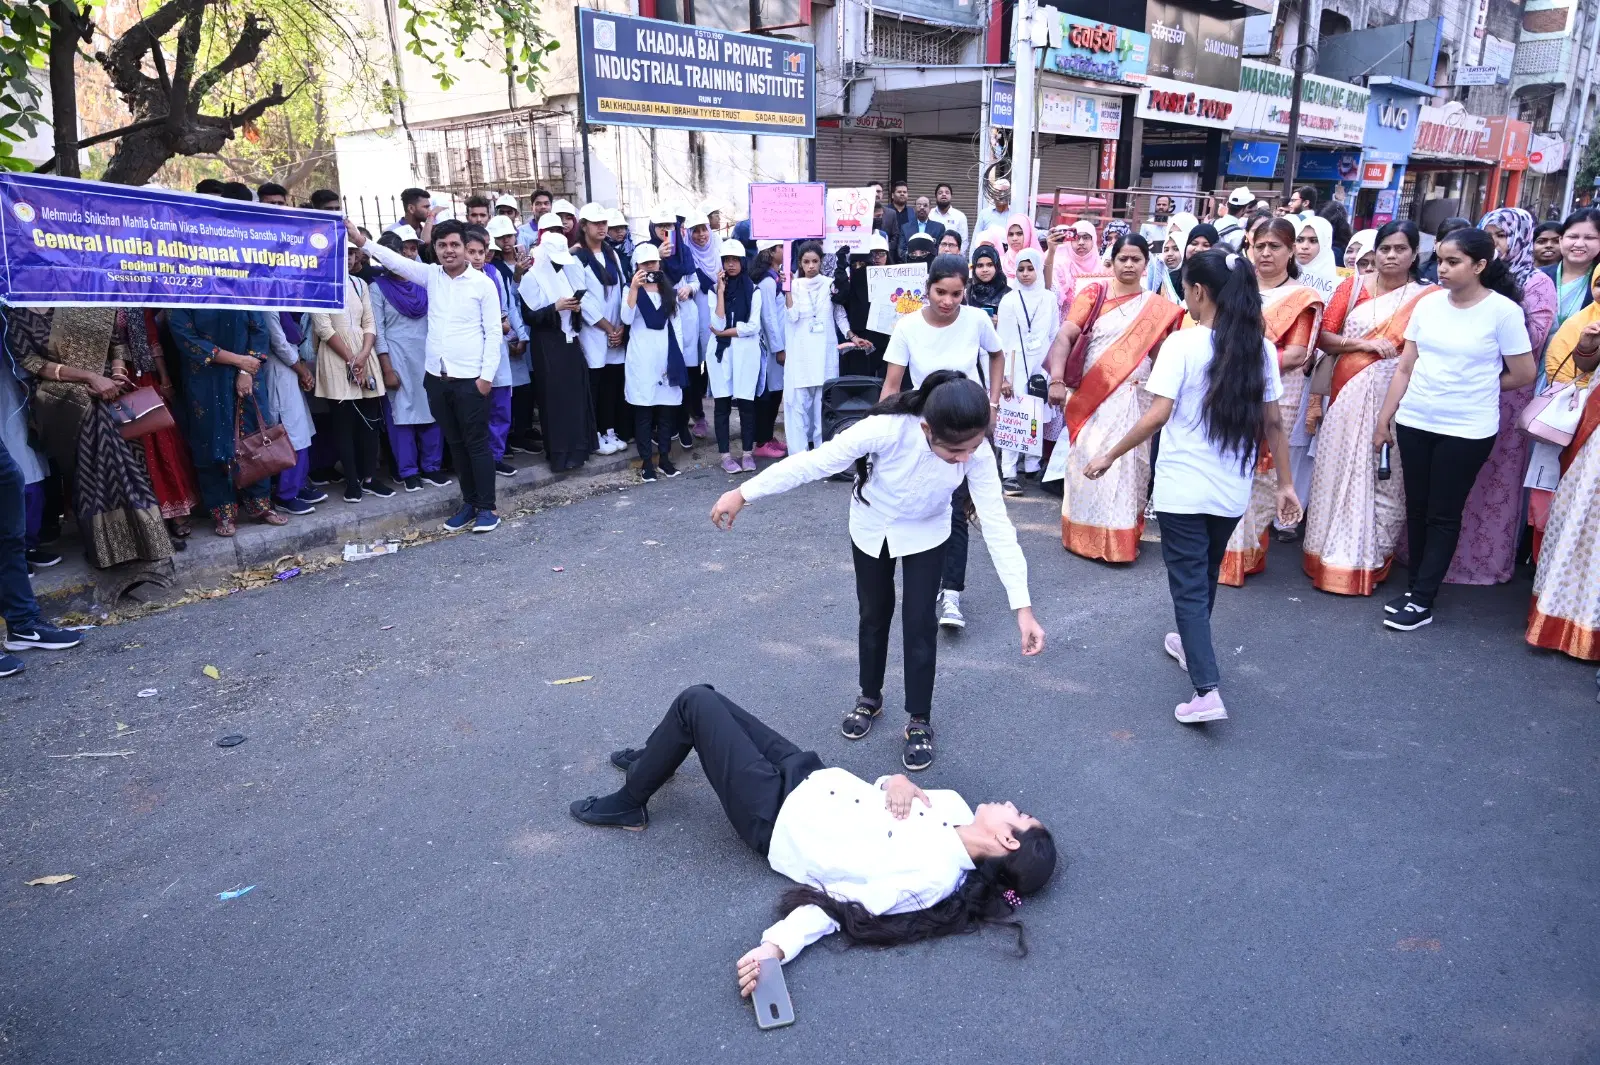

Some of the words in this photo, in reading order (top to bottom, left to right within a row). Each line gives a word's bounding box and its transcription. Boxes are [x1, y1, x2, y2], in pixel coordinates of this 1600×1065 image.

[636, 28, 695, 58] KHADIJA
[698, 38, 719, 61] BAI
[724, 42, 772, 68] PRIVATE
[1204, 38, 1238, 59] SAMSUNG
[594, 54, 683, 86] INDUSTRIAL
[685, 65, 742, 92] TRAINING
[746, 72, 804, 98] INSTITUTE
[995, 92, 1012, 103] mee
[1148, 90, 1186, 113] POSH
[1186, 92, 1197, 115] &
[1302, 80, 1345, 108] MEDICINE
[600, 100, 612, 109] BAI
[613, 101, 640, 111] KHADIJA
[642, 104, 652, 112] BAI
[655, 105, 671, 114] HAJI
[672, 106, 698, 116] IBRAHIM
[722, 111, 740, 120] TRUST
[780, 115, 803, 124] NAGPUR
[994, 104, 1012, 115] mee
[1238, 153, 1269, 164] vivo
[1368, 168, 1382, 177] JBL
[41, 206, 82, 222] Mehmuda
[85, 211, 120, 226] Shikshan
[122, 215, 149, 229] Mahila
[151, 218, 177, 231] Gramin
[178, 221, 198, 234] Vikas
[200, 224, 248, 241] Bahuddeshiya
[250, 230, 277, 241] Sanstha
[32, 228, 102, 252] Central
[105, 236, 153, 255] India
[158, 239, 240, 262] Adhyapak
[240, 248, 318, 269] Vidyalaya
[107, 272, 152, 283] Sessions
[164, 276, 203, 288] 2022-23
[121, 260, 157, 272] Godhni
[178, 264, 212, 276] Godhni
[215, 266, 250, 278] Nagpur
